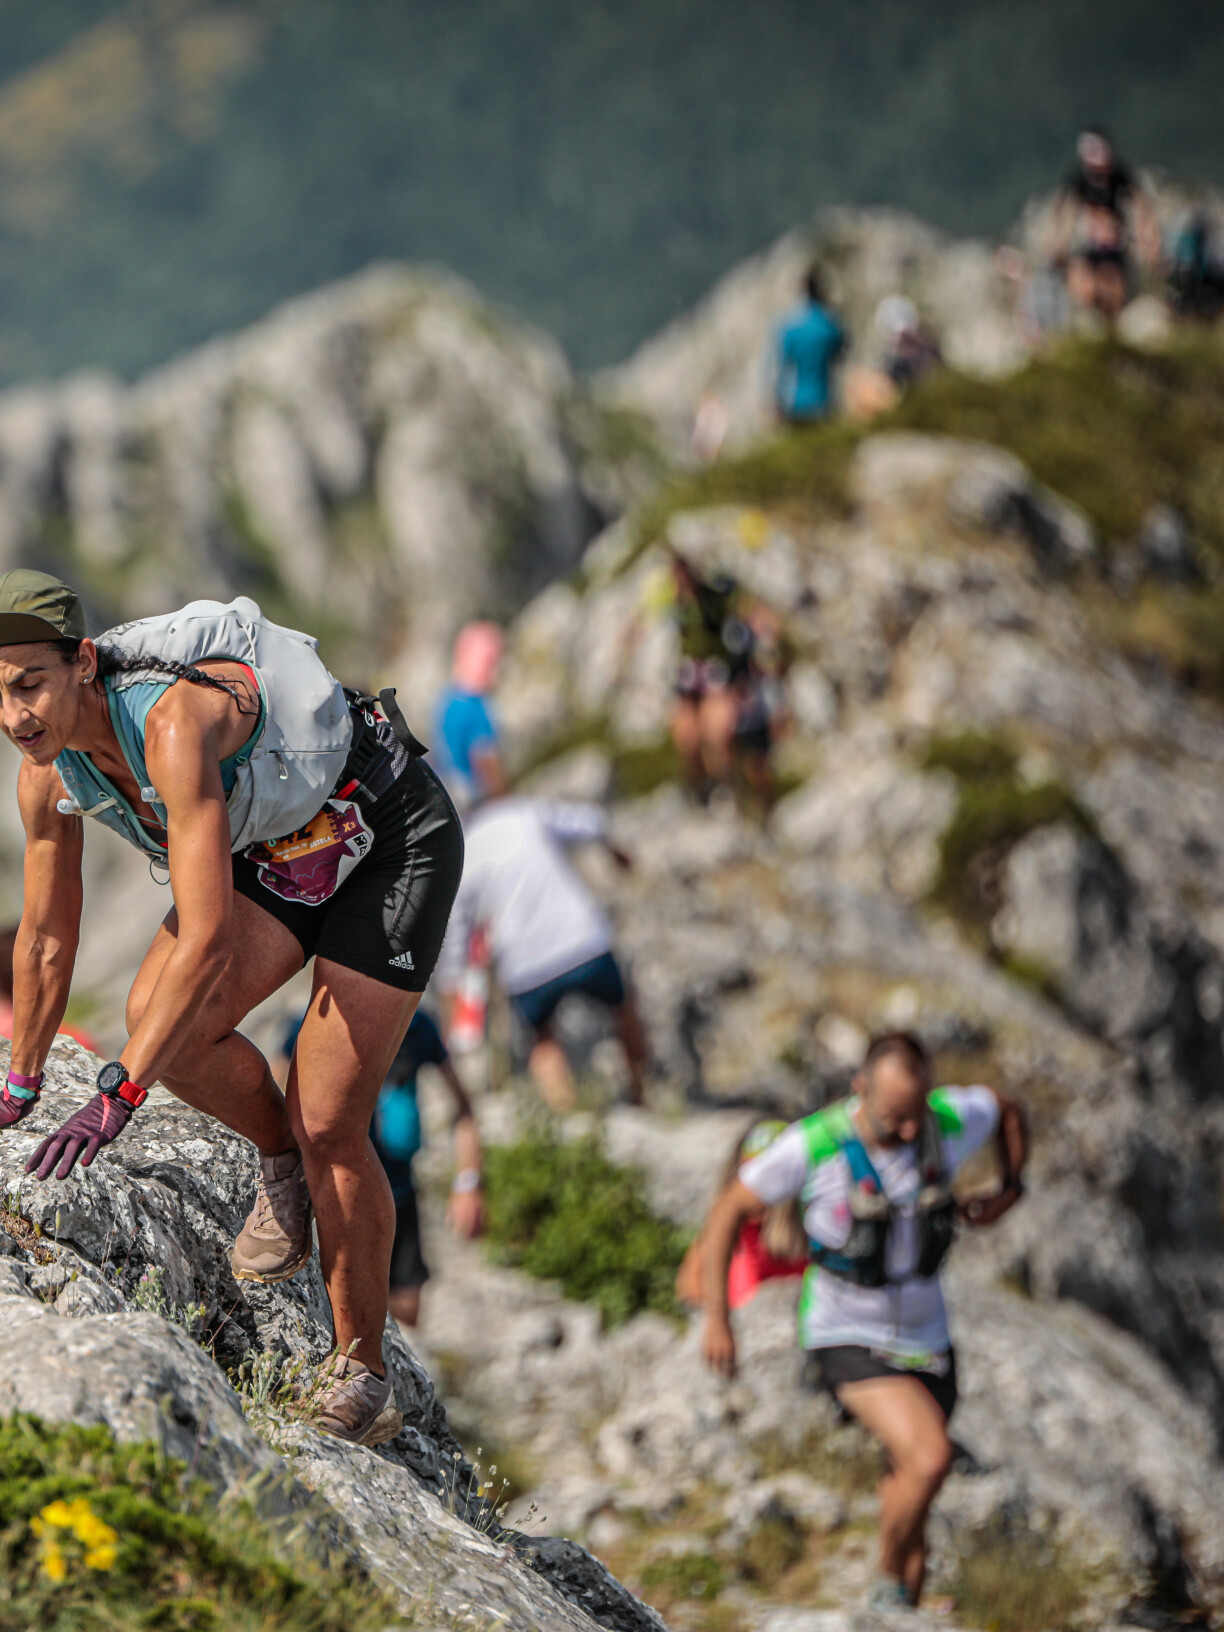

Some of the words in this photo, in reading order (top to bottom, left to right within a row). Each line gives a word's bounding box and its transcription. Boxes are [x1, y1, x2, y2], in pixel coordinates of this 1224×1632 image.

[342, 821, 356, 833] X3
[309, 835, 332, 849] ESTELA
[388, 959, 415, 971] adidas
